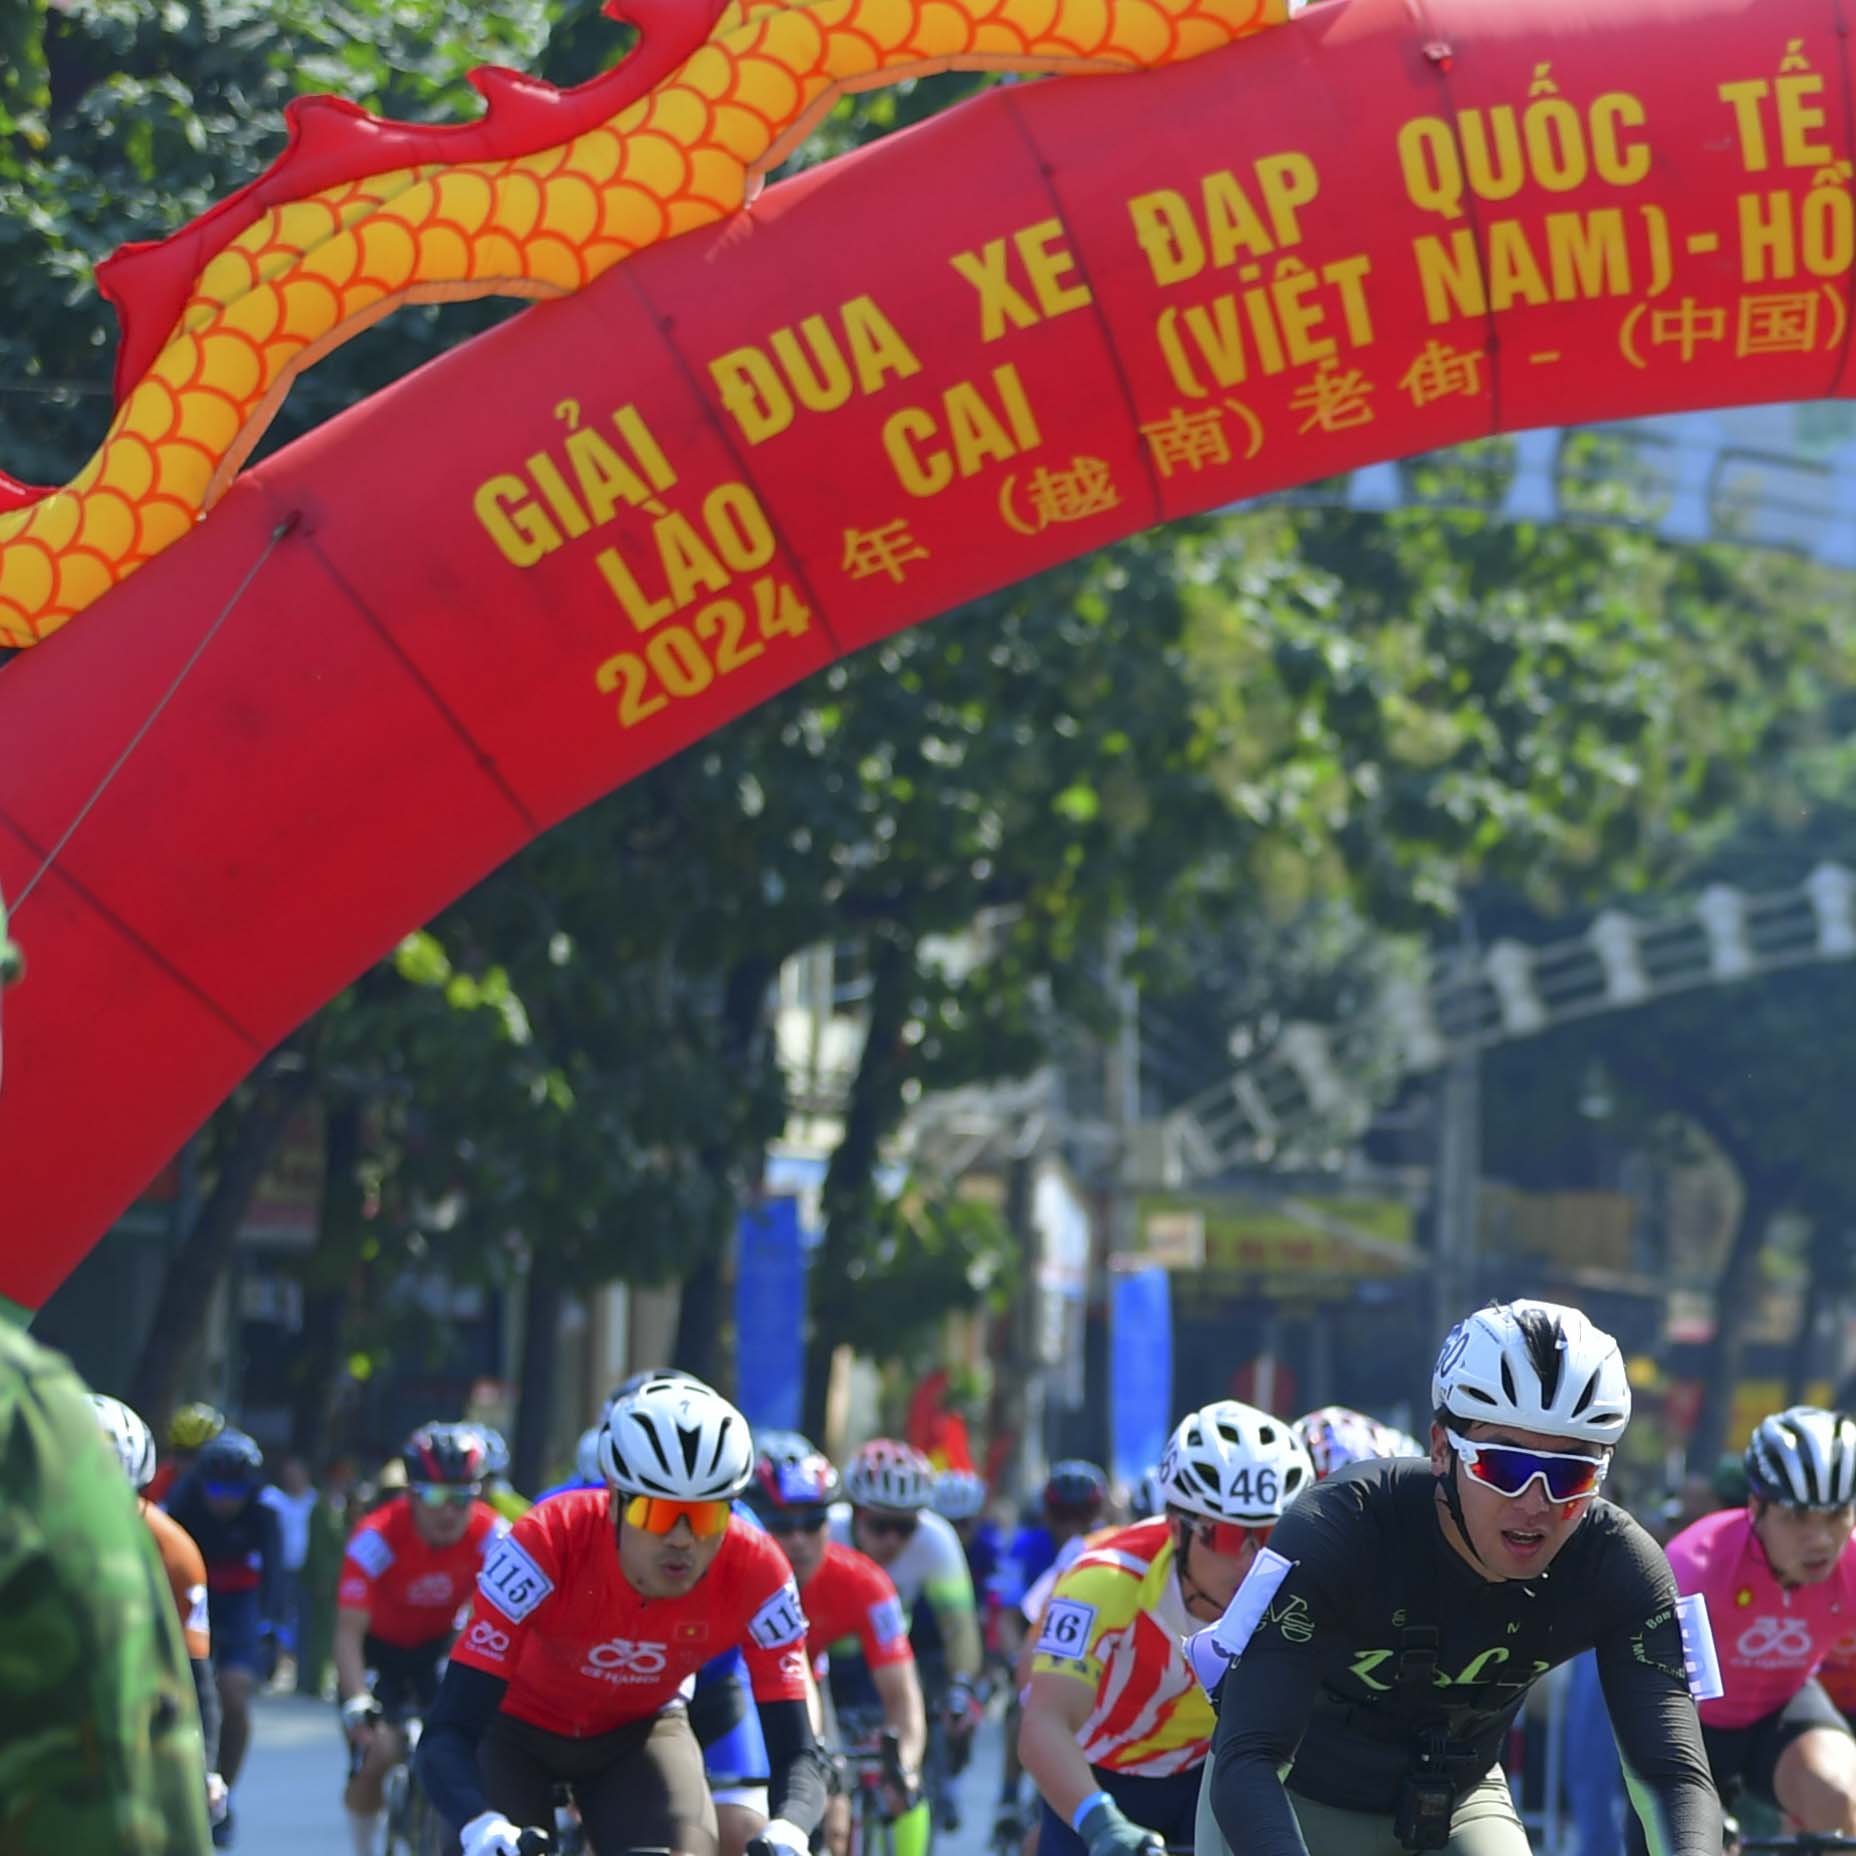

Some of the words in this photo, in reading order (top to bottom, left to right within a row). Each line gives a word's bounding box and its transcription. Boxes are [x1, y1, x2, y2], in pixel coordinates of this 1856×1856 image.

[474, 398, 678, 567] GIẢI
[708, 296, 921, 443] ĐUA
[951, 218, 1092, 341] XE
[1128, 152, 1319, 287] ĐẠP
[1398, 63, 1651, 214] QUỐC
[1719, 39, 1834, 171] TẾ
[597, 482, 776, 631] LÀO
[882, 364, 1041, 496] CAI
[1157, 255, 1374, 397] (VIỆT
[1229, 1468, 1279, 1507] 46
[486, 1552, 537, 1607] 115
[763, 1594, 800, 1641] 11
